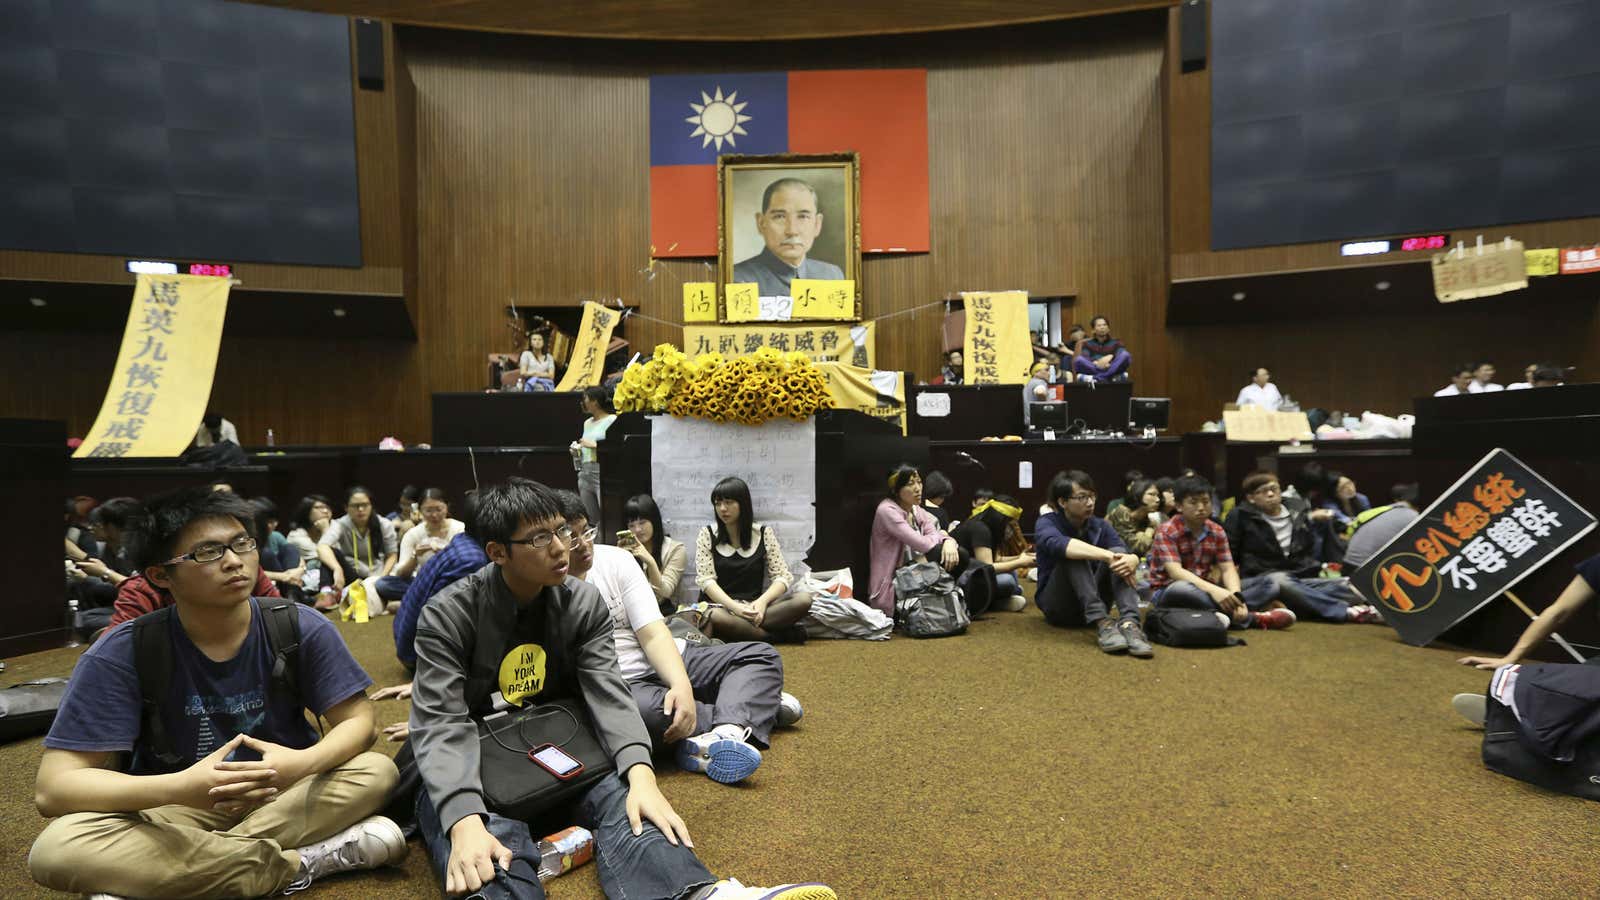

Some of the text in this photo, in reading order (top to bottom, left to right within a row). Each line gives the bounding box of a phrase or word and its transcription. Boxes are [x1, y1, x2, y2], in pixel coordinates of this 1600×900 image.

[1438, 498, 1562, 591] 不要蠻幹
[514, 665, 535, 680] YOUR
[507, 679, 540, 695] DREAM
